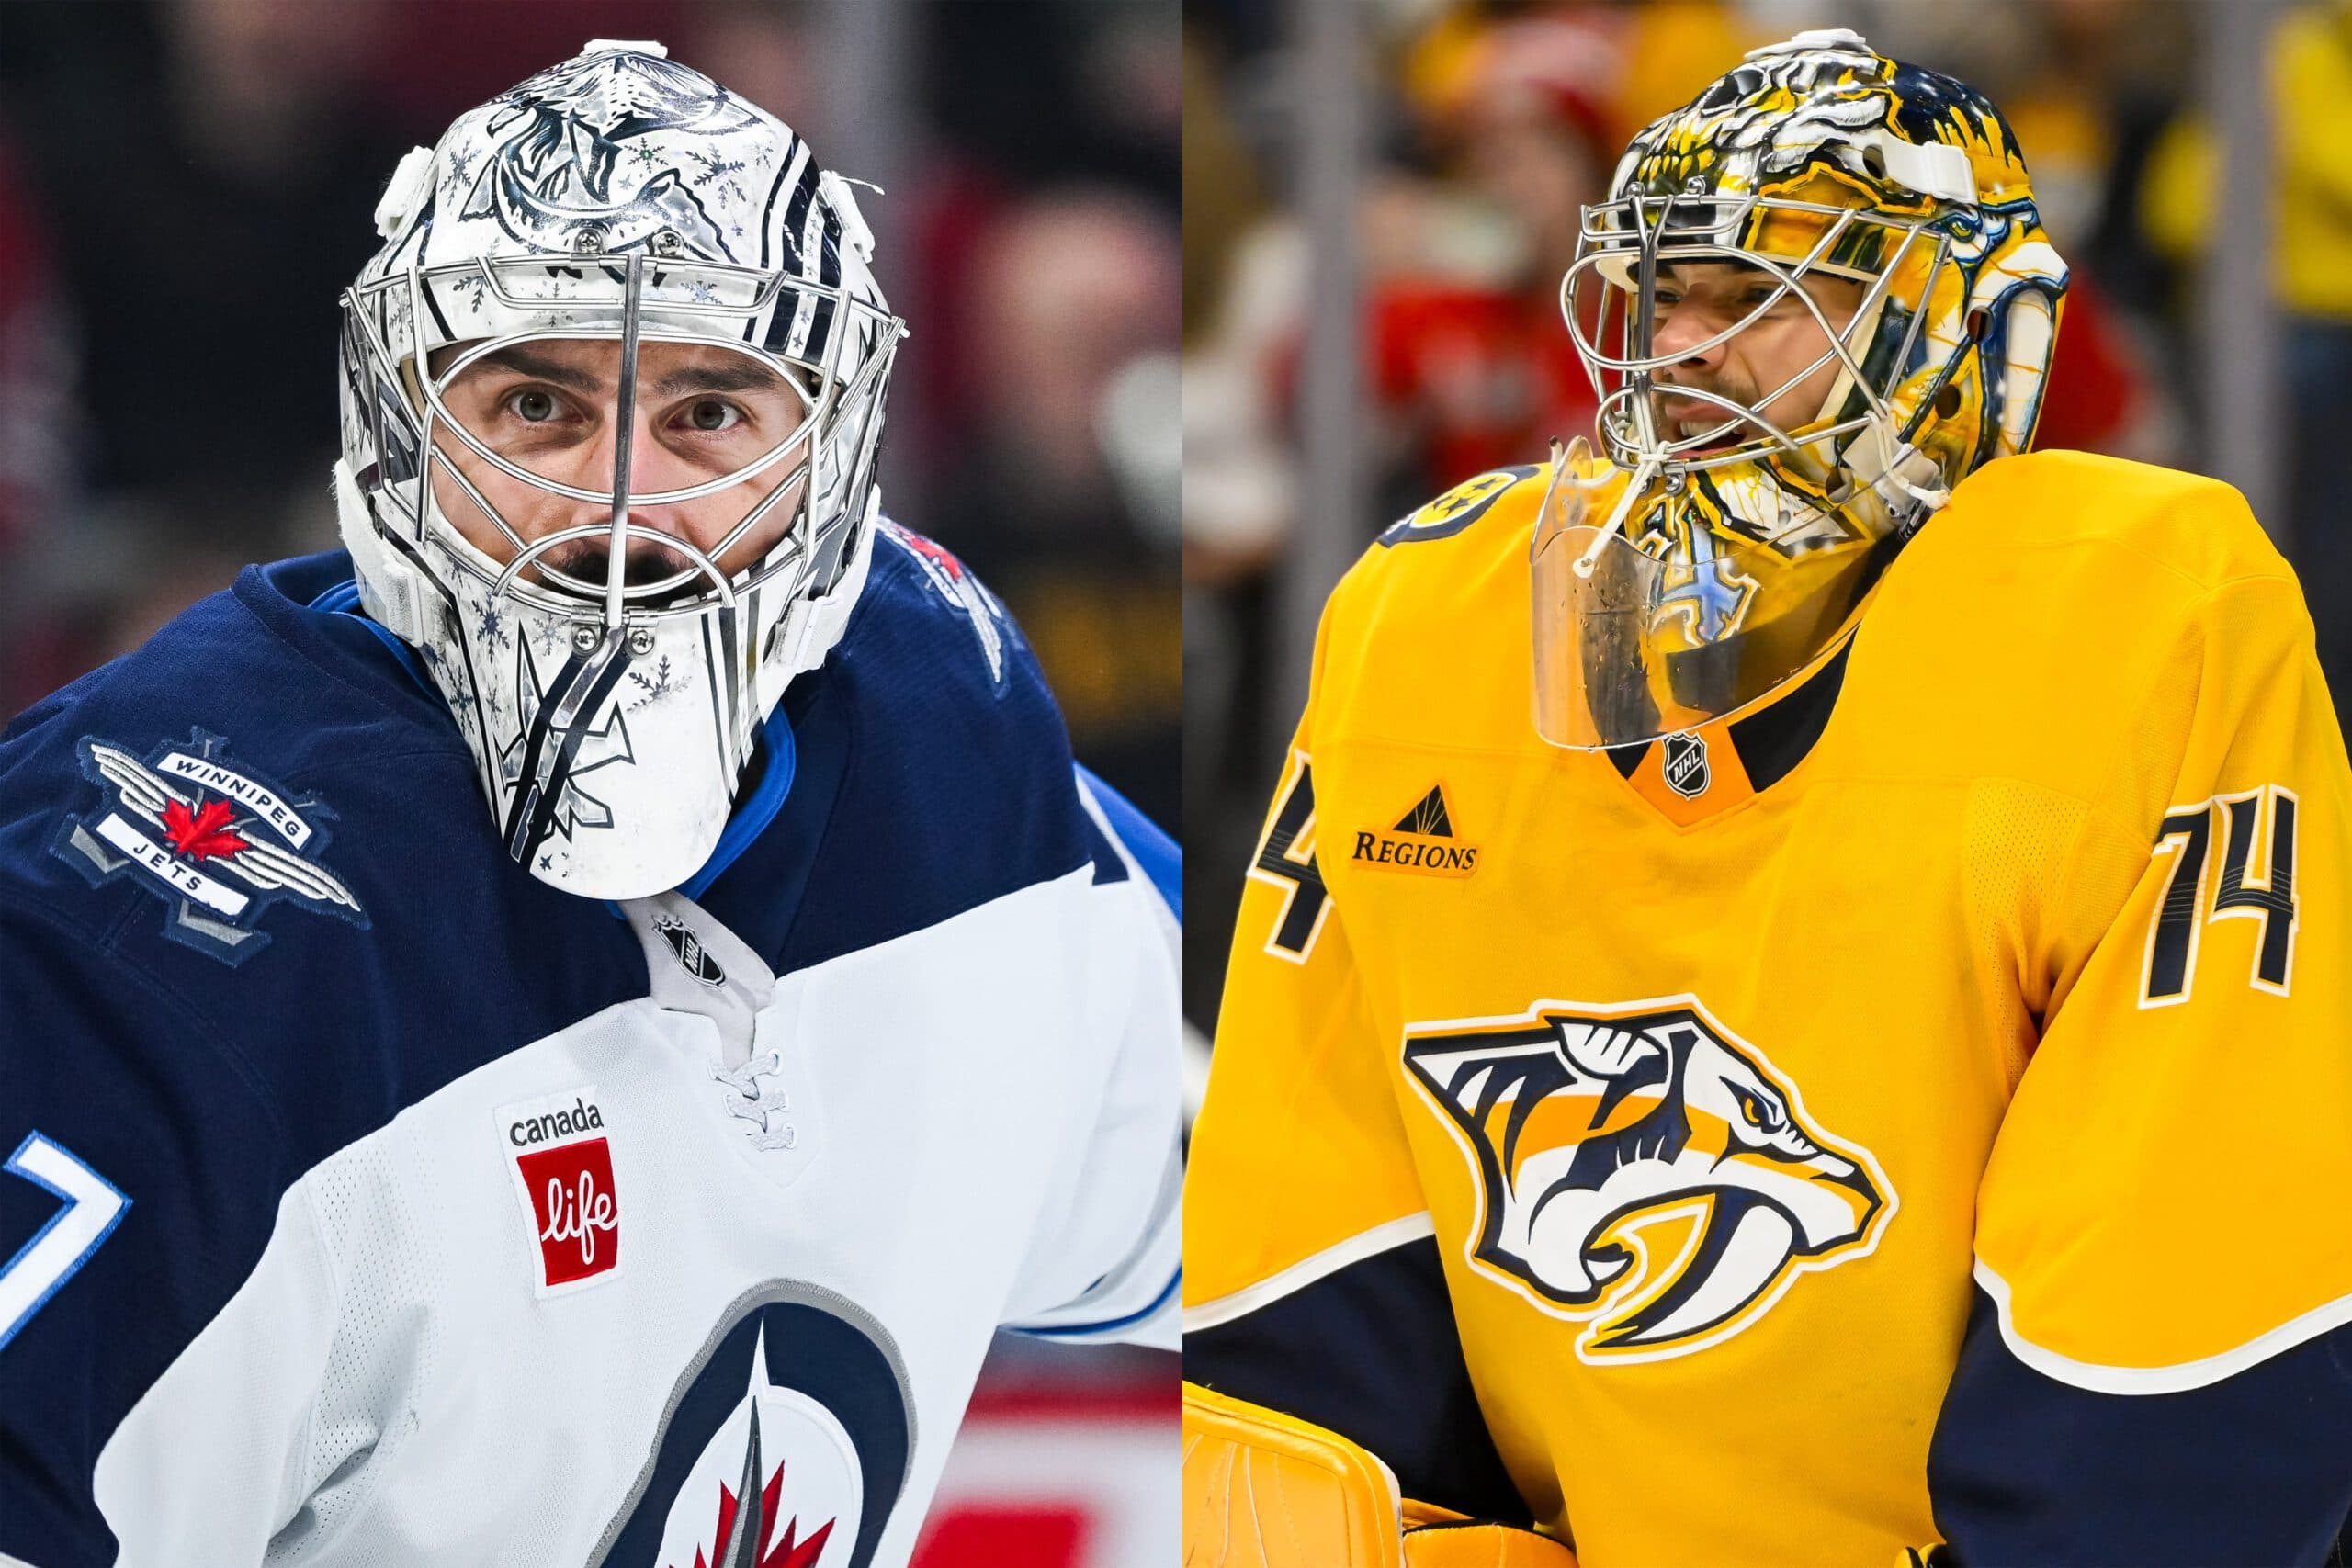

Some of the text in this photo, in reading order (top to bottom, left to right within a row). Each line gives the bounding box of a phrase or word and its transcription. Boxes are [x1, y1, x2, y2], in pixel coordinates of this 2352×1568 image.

[1674, 749, 1700, 782] NHL
[176, 759, 300, 837] WINNIPEG
[133, 843, 202, 891] JETS
[2137, 783, 2300, 1010] 74
[509, 1097, 604, 1147] canada
[540, 1170, 618, 1265] life
